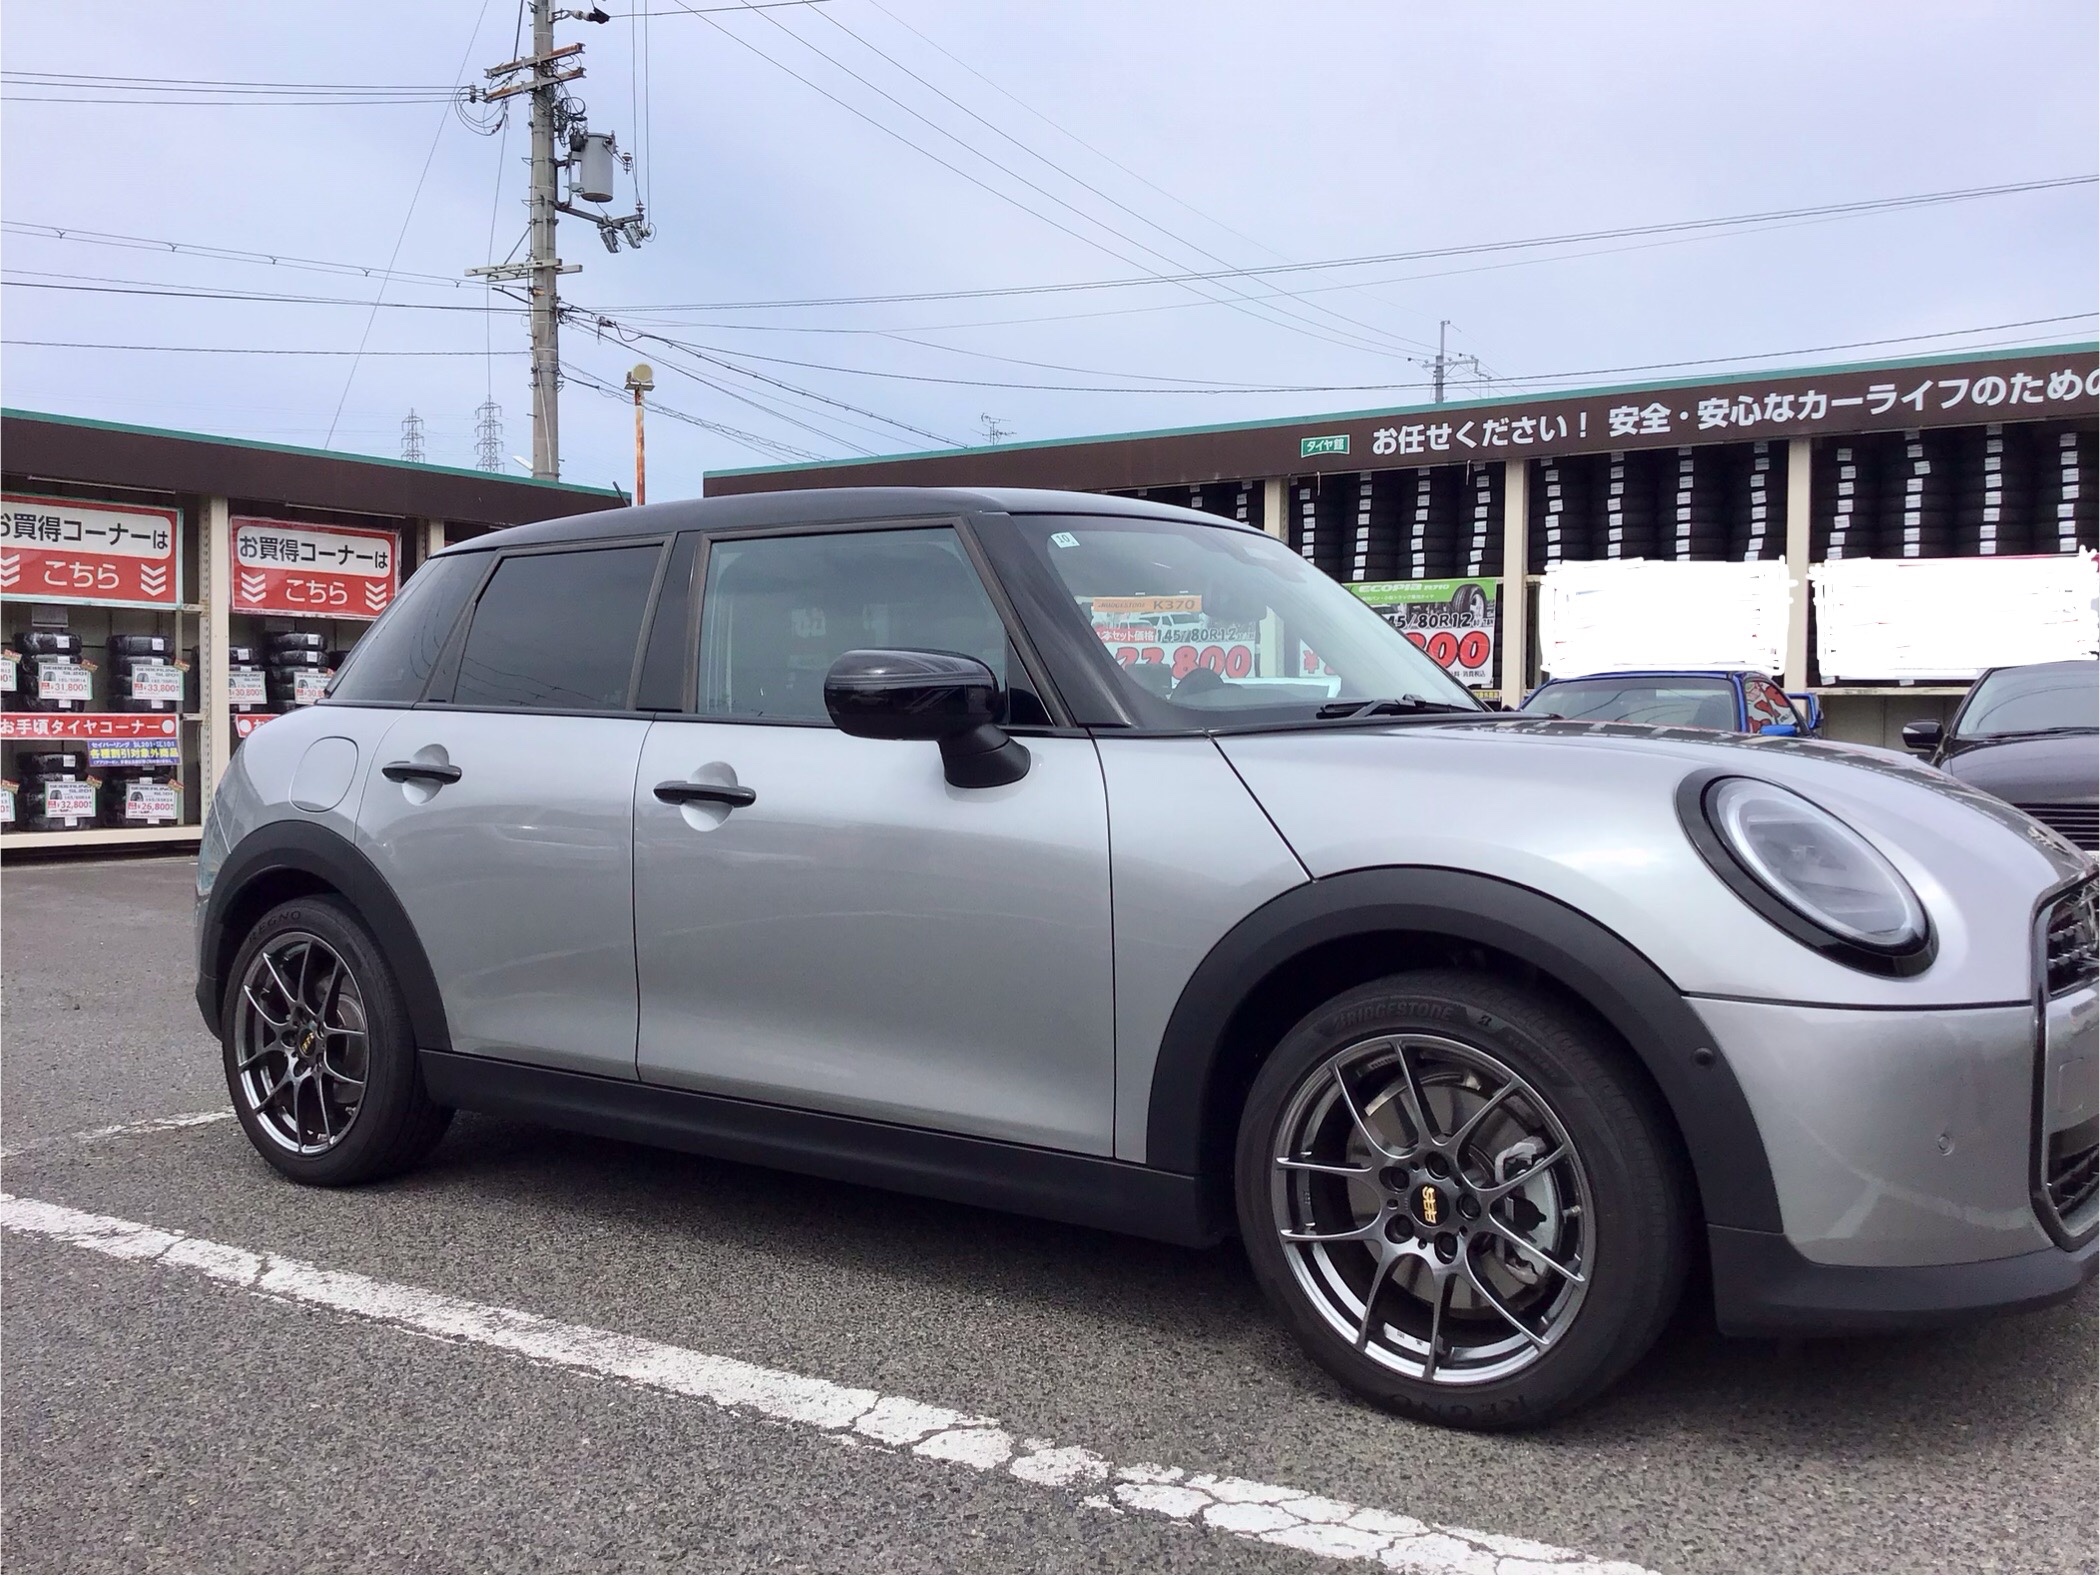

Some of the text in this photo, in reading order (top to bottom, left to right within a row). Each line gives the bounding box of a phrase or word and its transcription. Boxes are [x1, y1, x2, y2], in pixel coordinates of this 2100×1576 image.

[1306, 438, 1345, 453] タイヤ館
[239, 535, 388, 569] お買得コーナーは
[43, 560, 120, 589] こちら
[285, 579, 348, 605] こちら
[1153, 600, 1195, 610] K370
[1157, 628, 1237, 642] 145/80R12
[1422, 1186, 1437, 1224] BBS
